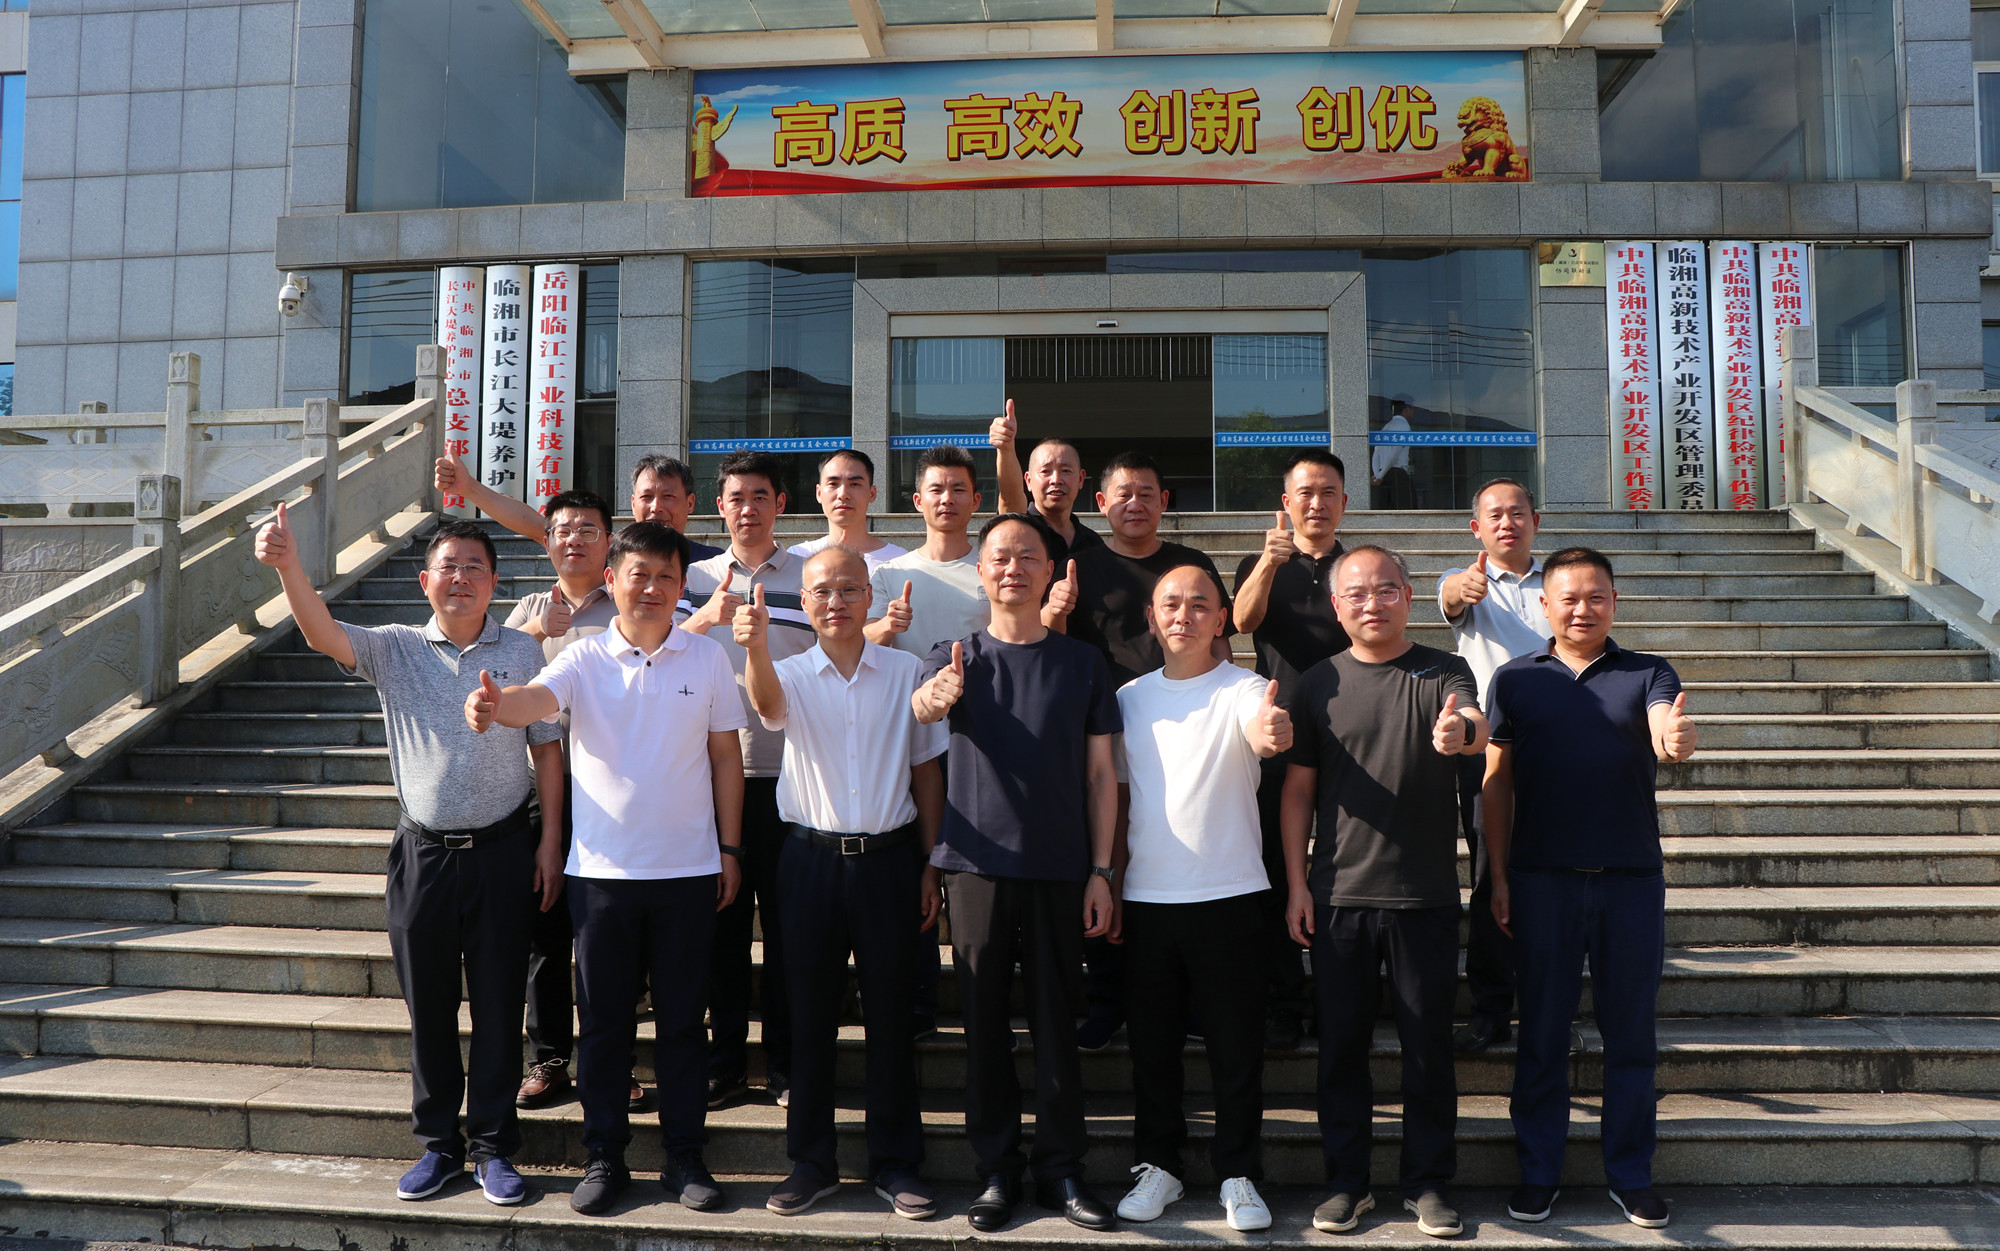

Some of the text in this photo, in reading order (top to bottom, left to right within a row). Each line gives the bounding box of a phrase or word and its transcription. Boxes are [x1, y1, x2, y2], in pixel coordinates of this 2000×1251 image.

[771, 83, 1439, 168] 高质 高效 创新 创优
[459, 280, 475, 381] 中共临湘市
[487, 279, 520, 496] 临湘市长江大堤养护
[536, 271, 569, 517] 岳阳临江工业科技有限
[1722, 246, 1758, 509] 中共临湘高新技术产业开发区纪律检查工作委
